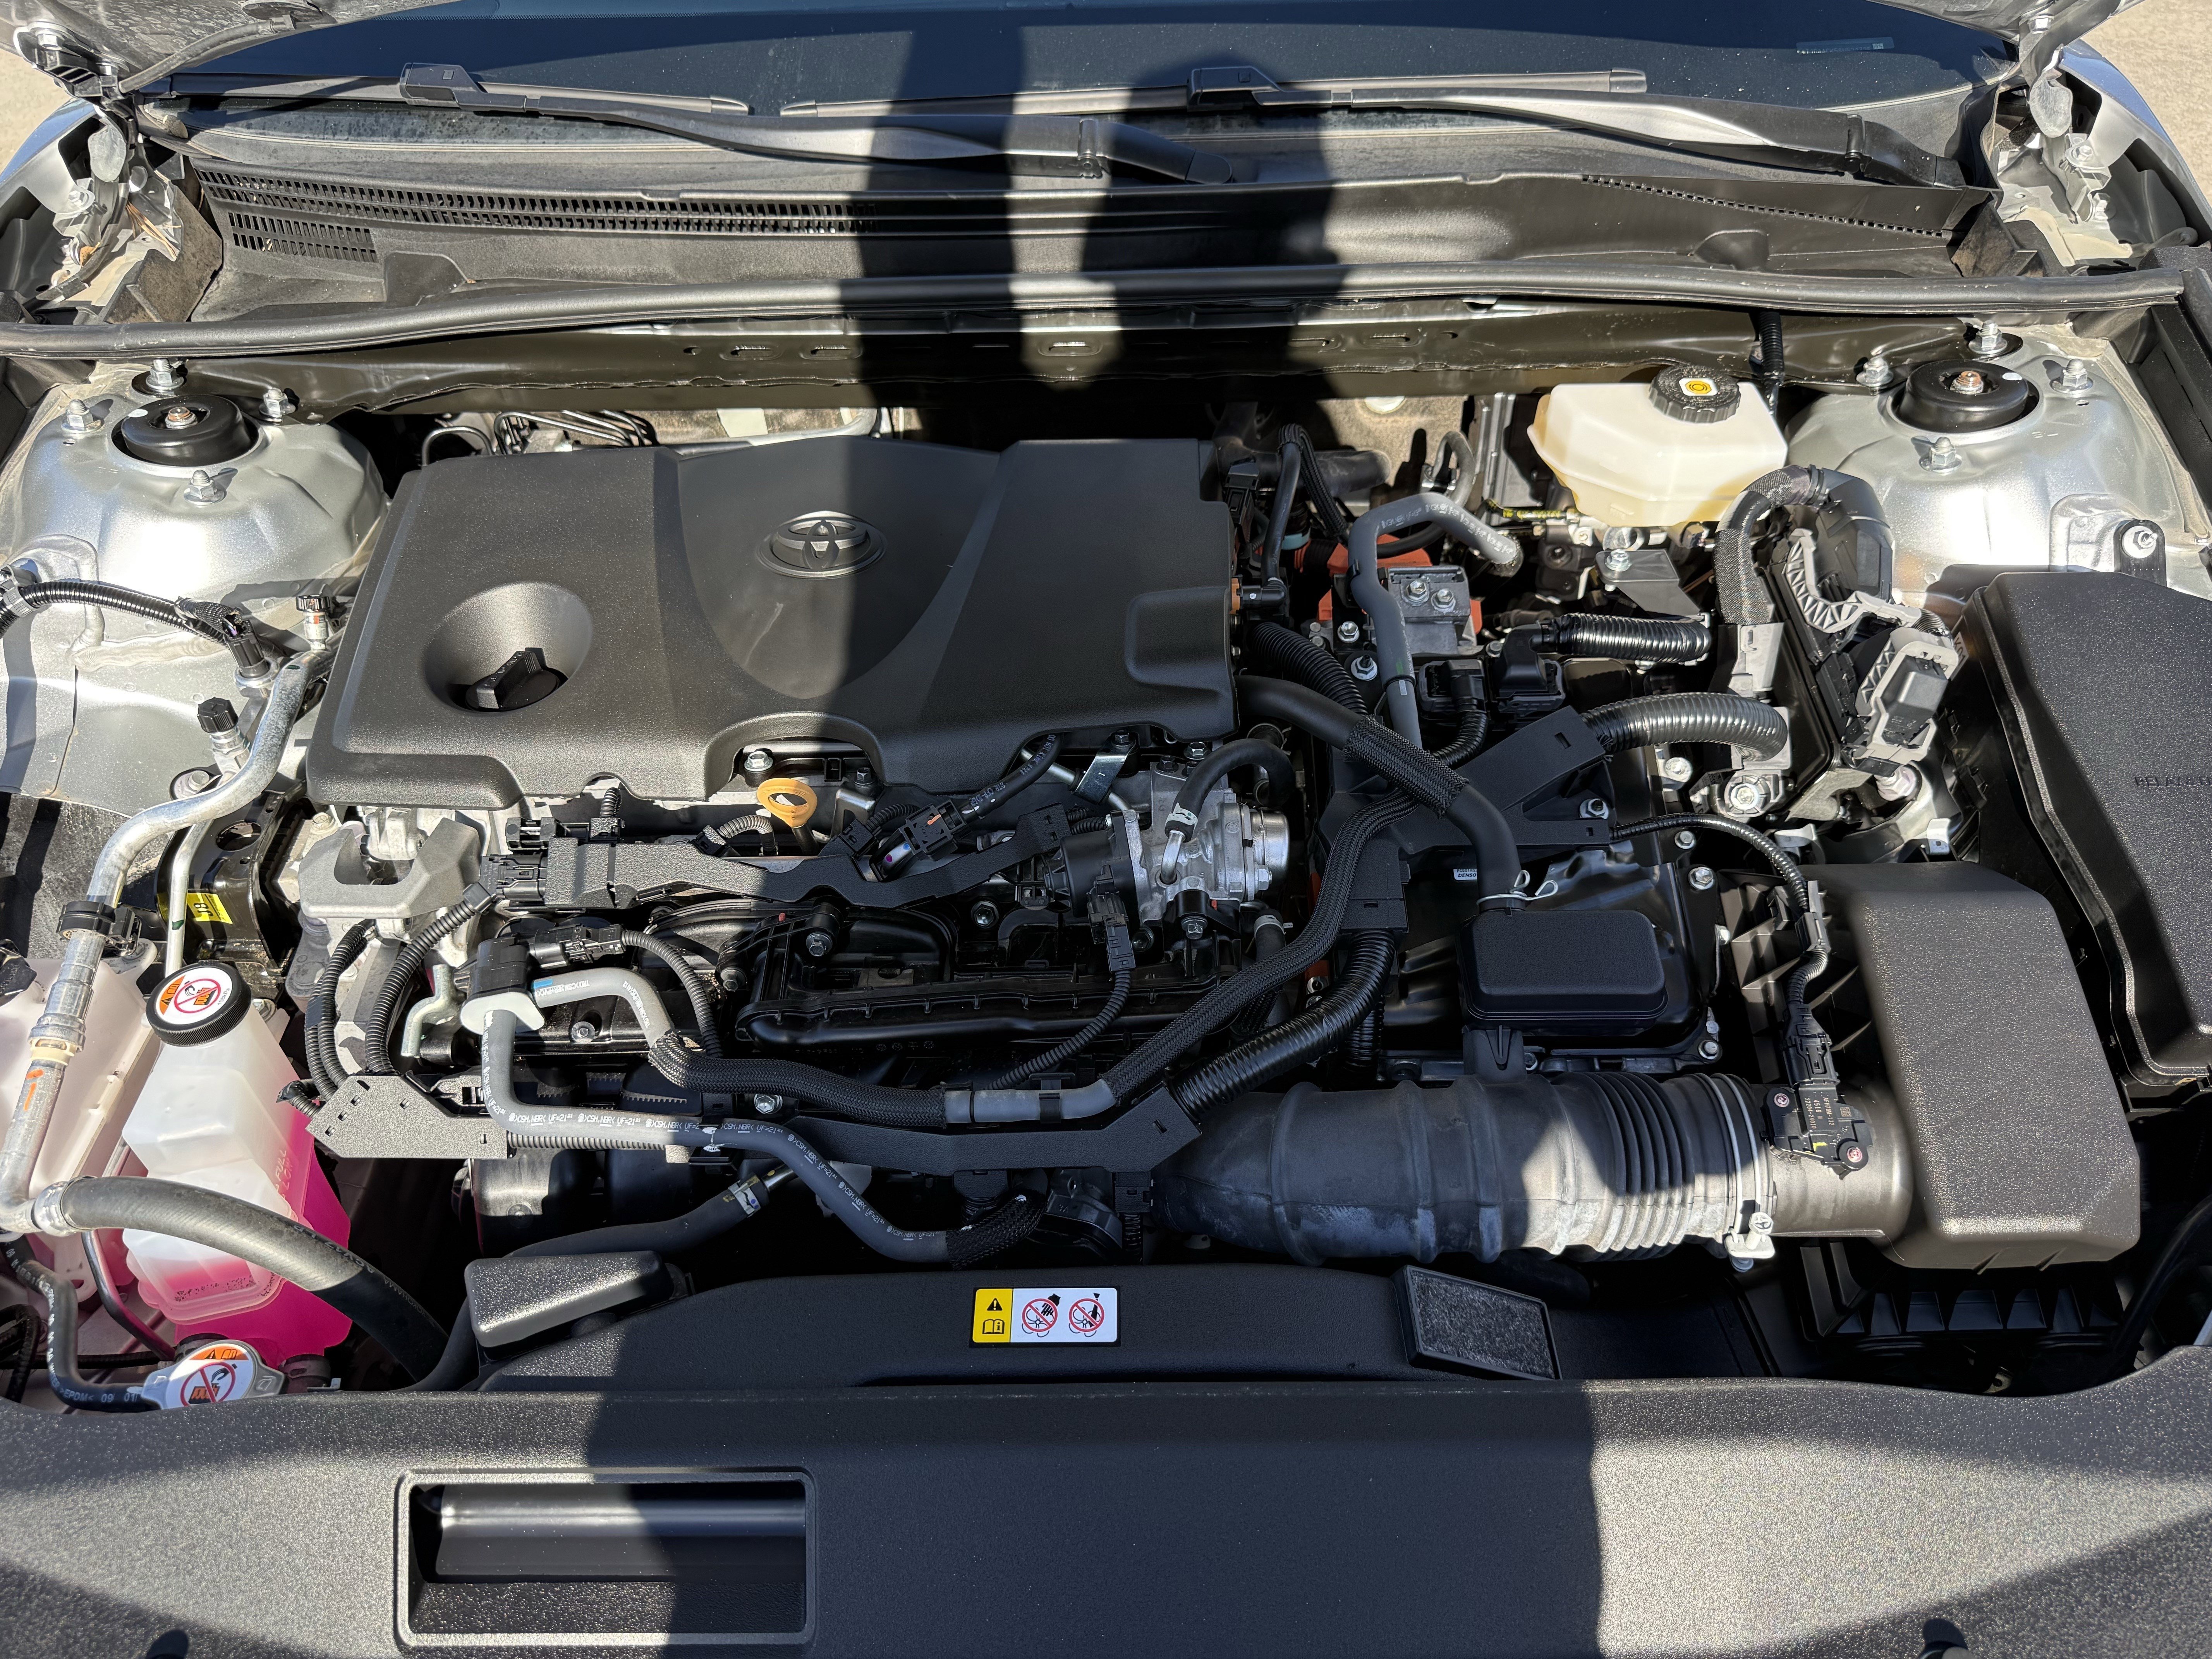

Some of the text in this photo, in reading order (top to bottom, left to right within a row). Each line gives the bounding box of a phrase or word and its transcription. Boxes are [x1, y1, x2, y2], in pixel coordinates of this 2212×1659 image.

[1805, 1097, 1817, 1129] 22204-24010
[275, 1149, 286, 1182] FULL
[282, 1158, 293, 1190] LOW
